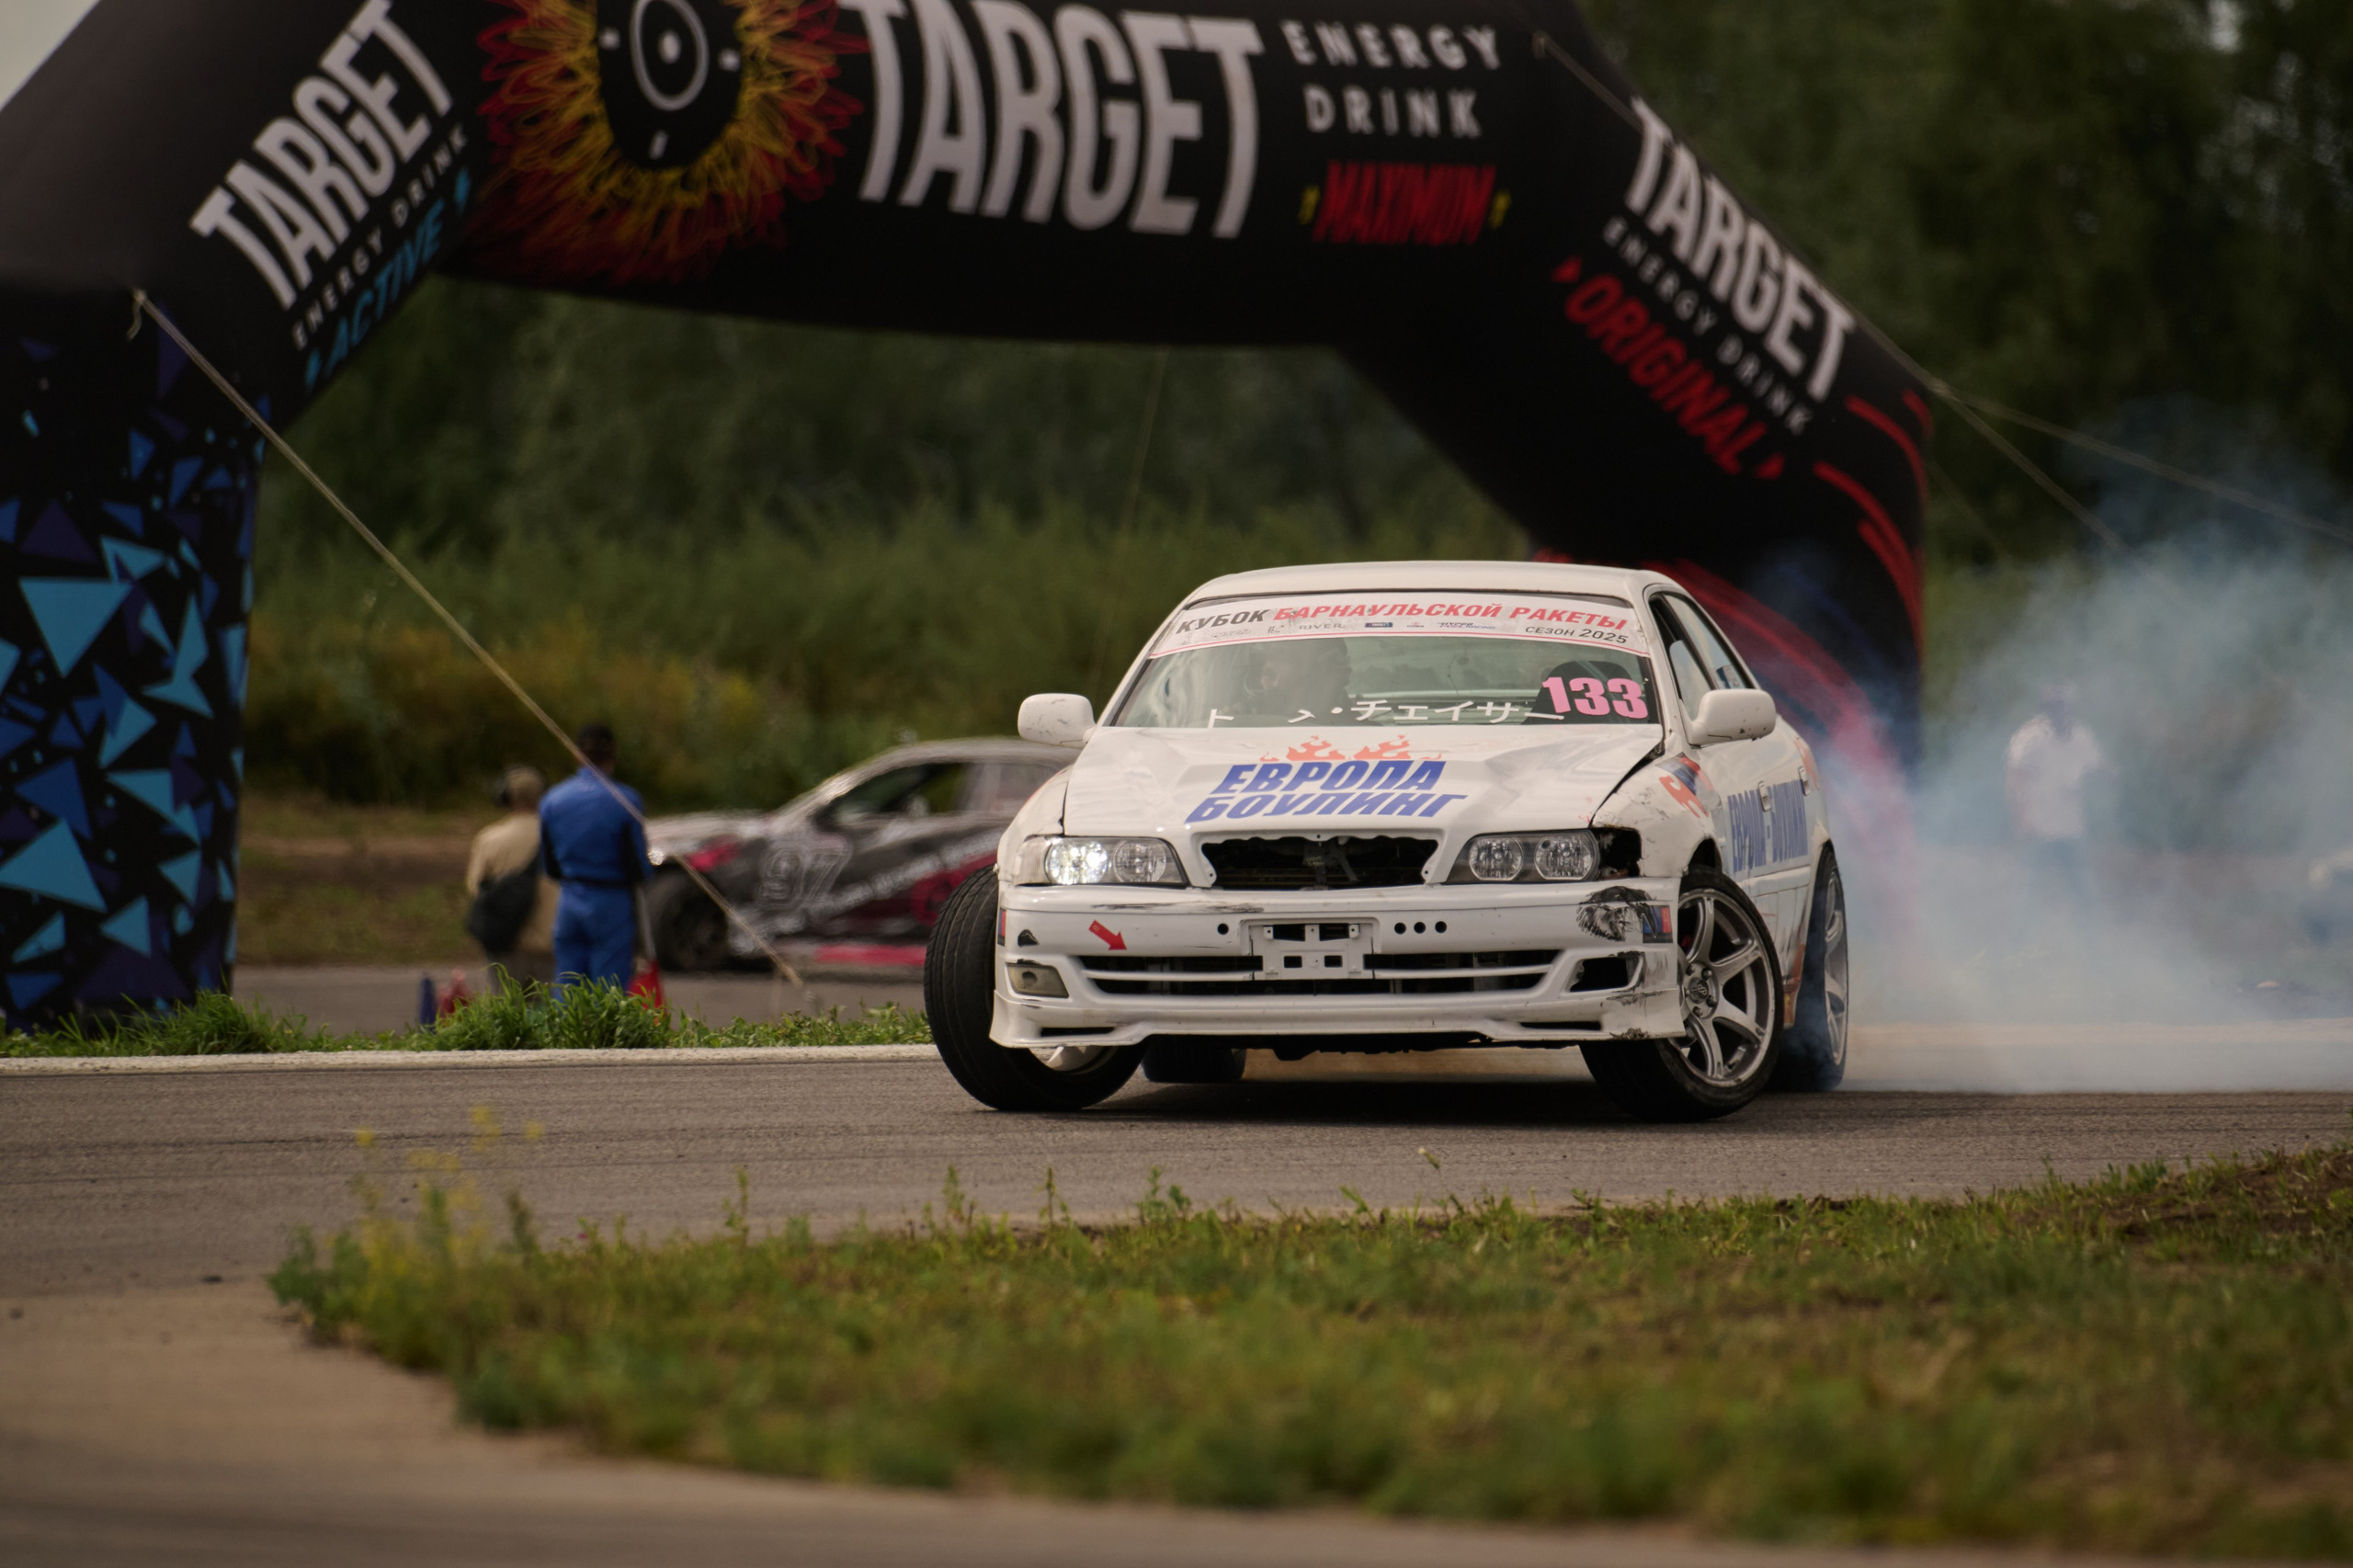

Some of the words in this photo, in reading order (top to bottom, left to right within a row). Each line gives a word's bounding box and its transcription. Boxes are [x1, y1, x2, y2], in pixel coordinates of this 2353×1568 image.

[1280, 18, 1501, 71] ENERGY
[190, 0, 452, 310] TARGET
[840, 0, 1265, 238] TARGET
[1303, 84, 1482, 140] DRINK
[291, 224, 382, 352] ENERGY
[390, 122, 469, 229] DRINK
[324, 197, 447, 379] ACTIVE
[1624, 95, 1855, 403] TARGET
[1564, 274, 1768, 475] ORIGINAL
[1601, 215, 1718, 336] ENERGY
[1717, 335, 1813, 436] DRINK
[1176, 609, 1270, 634] КУБОК
[1273, 603, 1504, 621] БАРНАУЛЬСКОЙ
[1509, 607, 1628, 630] РАКЕТЫ
[1525, 626, 1575, 637] СЕЗОН
[1579, 629, 1629, 644] 2025
[1542, 677, 1648, 719] 133
[1183, 792, 1469, 824] БОУЛИНГ
[1209, 760, 1447, 795] ЕВРОПА
